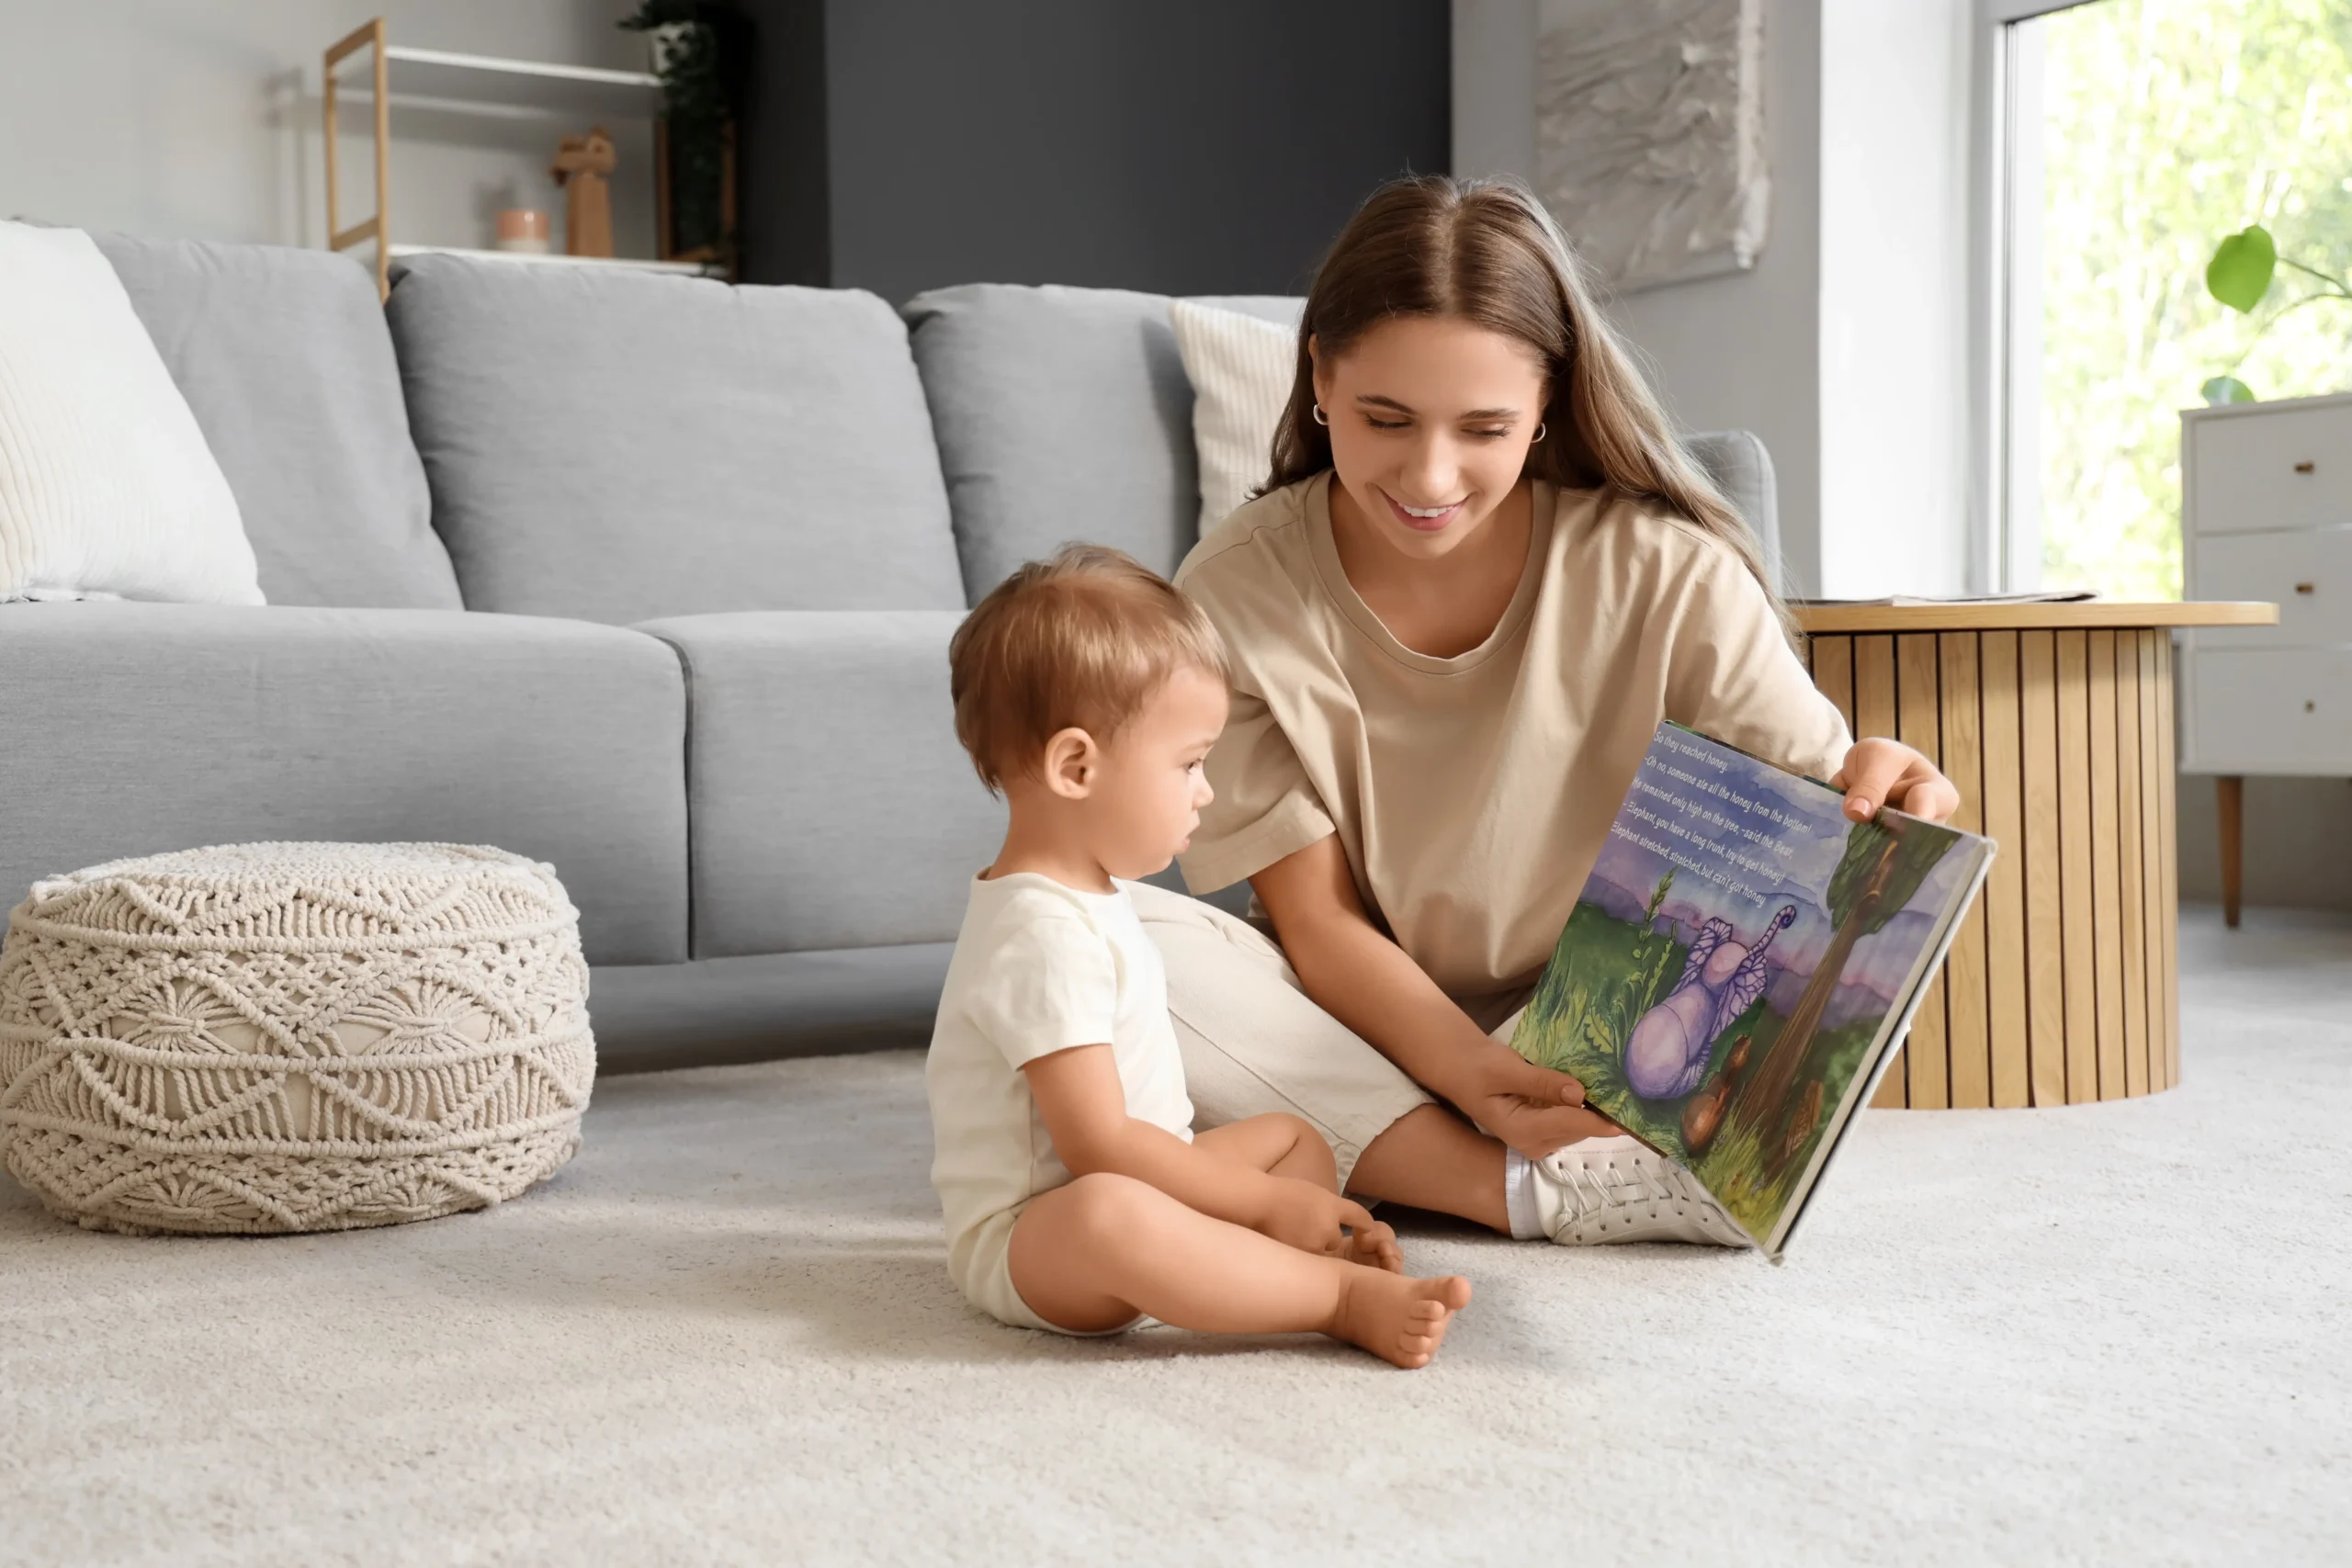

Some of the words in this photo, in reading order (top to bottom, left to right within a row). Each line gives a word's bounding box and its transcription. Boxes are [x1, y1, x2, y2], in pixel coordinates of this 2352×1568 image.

[1654, 731, 1663, 743] So
[1664, 735, 1679, 752] they
[1679, 744, 1708, 761] reached
[1706, 752, 1728, 773] honey.
[1642, 783, 1674, 803] remained
[1672, 796, 1688, 813] only
[1686, 799, 1703, 818] high
[1702, 810, 1713, 820] on
[1712, 812, 1724, 827] the
[1724, 818, 1740, 836] tree,
[1760, 834, 1773, 849] the
[1773, 840, 1793, 860] Bear,
[1657, 762, 1667, 774] no,
[1667, 766, 1697, 784] someone
[1696, 779, 1707, 790] ate
[1707, 783, 1719, 795] all
[1717, 785, 1730, 799] the
[1729, 790, 1753, 813] honey
[1752, 801, 1770, 818] from
[1770, 808, 1783, 823] the
[1782, 813, 1813, 835] bottom!
[1611, 821, 1641, 843] Elephant
[1638, 836, 1670, 860] stretched,
[1668, 852, 1702, 875] stretched,
[1701, 863, 1714, 879] but
[1713, 873, 1731, 887] can't
[1727, 881, 1744, 894] got
[1742, 884, 1767, 908] honey
[1626, 801, 1657, 825] Elephant,
[1654, 818, 1669, 829] you
[1668, 819, 1685, 837] have
[1684, 830, 1690, 840] a
[1690, 830, 1707, 851] long
[1706, 839, 1725, 859] trunk,
[1725, 848, 1737, 864] try
[1736, 853, 1746, 865] to
[1743, 859, 1759, 872] get
[1758, 862, 1786, 886] honey!
